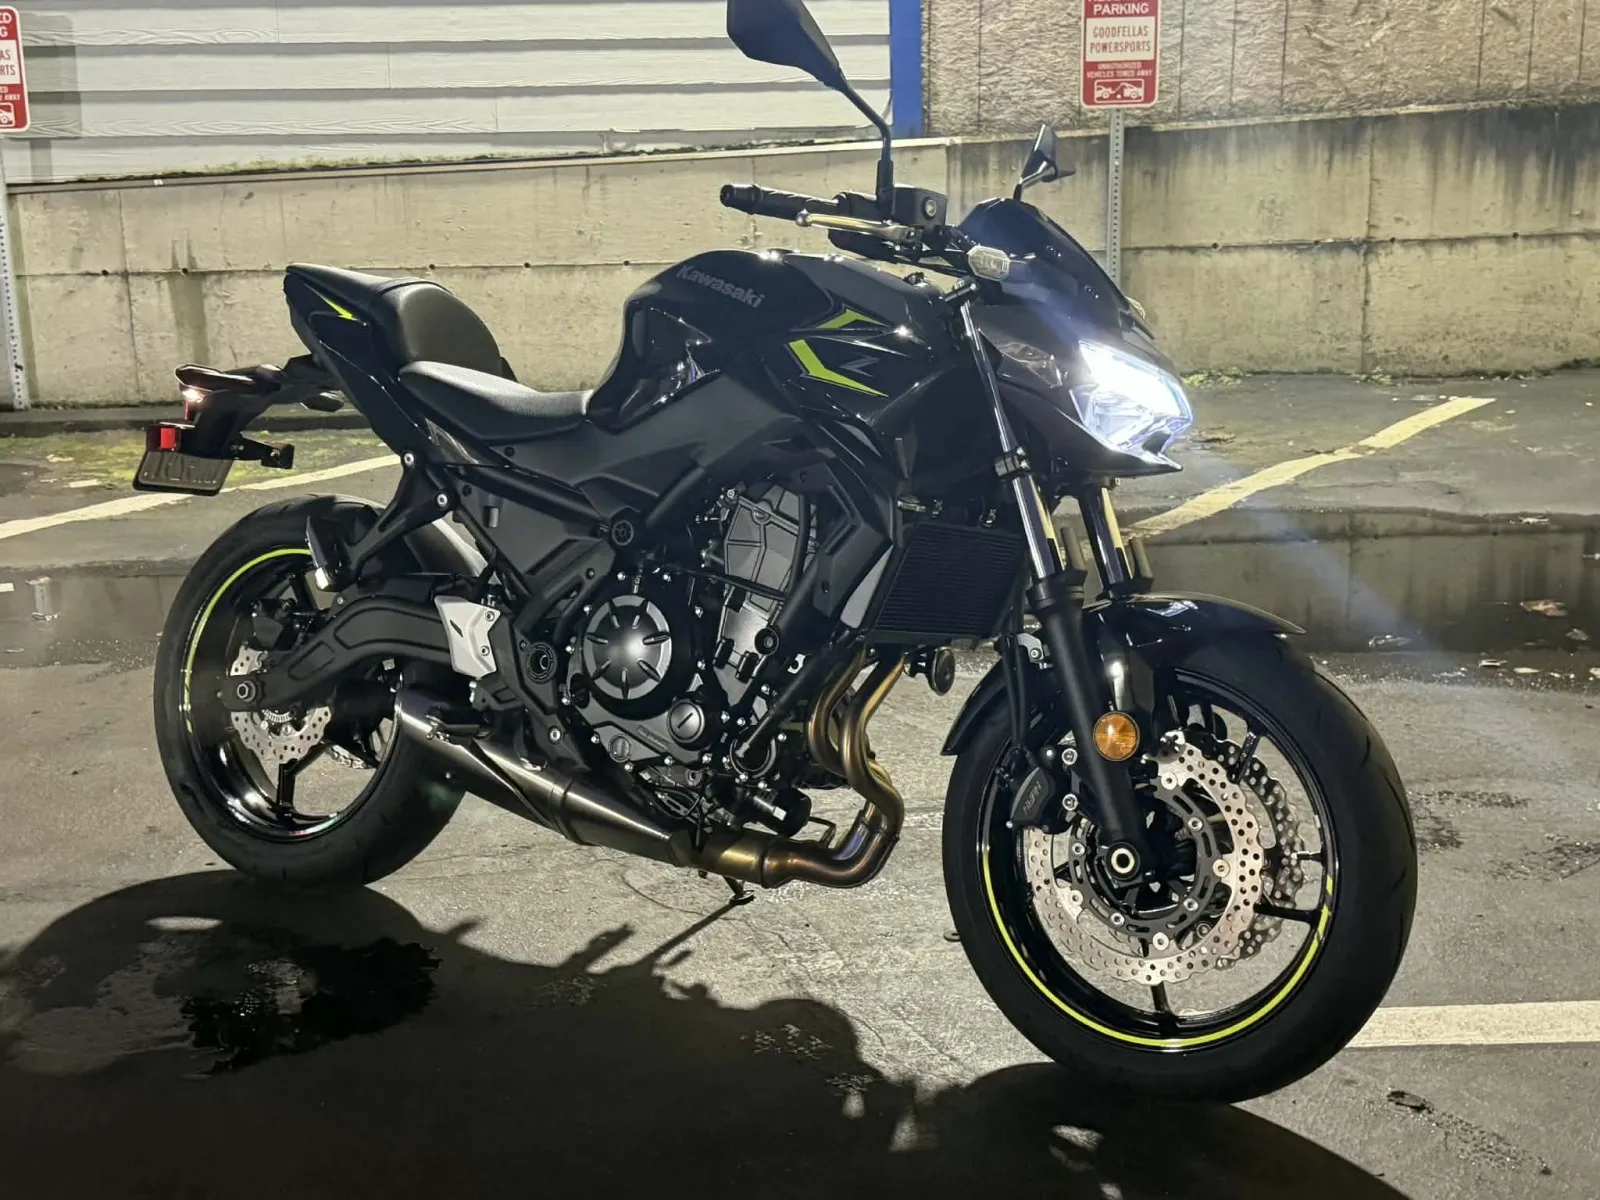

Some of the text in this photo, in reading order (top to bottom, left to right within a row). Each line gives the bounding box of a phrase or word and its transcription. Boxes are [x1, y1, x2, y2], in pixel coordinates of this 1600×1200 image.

[1093, 3, 1150, 15] PARKING
[1093, 25, 1149, 38] GOODFELLAS
[1090, 40, 1151, 54] POWERSPORTS
[676, 265, 765, 308] Kawasaki
